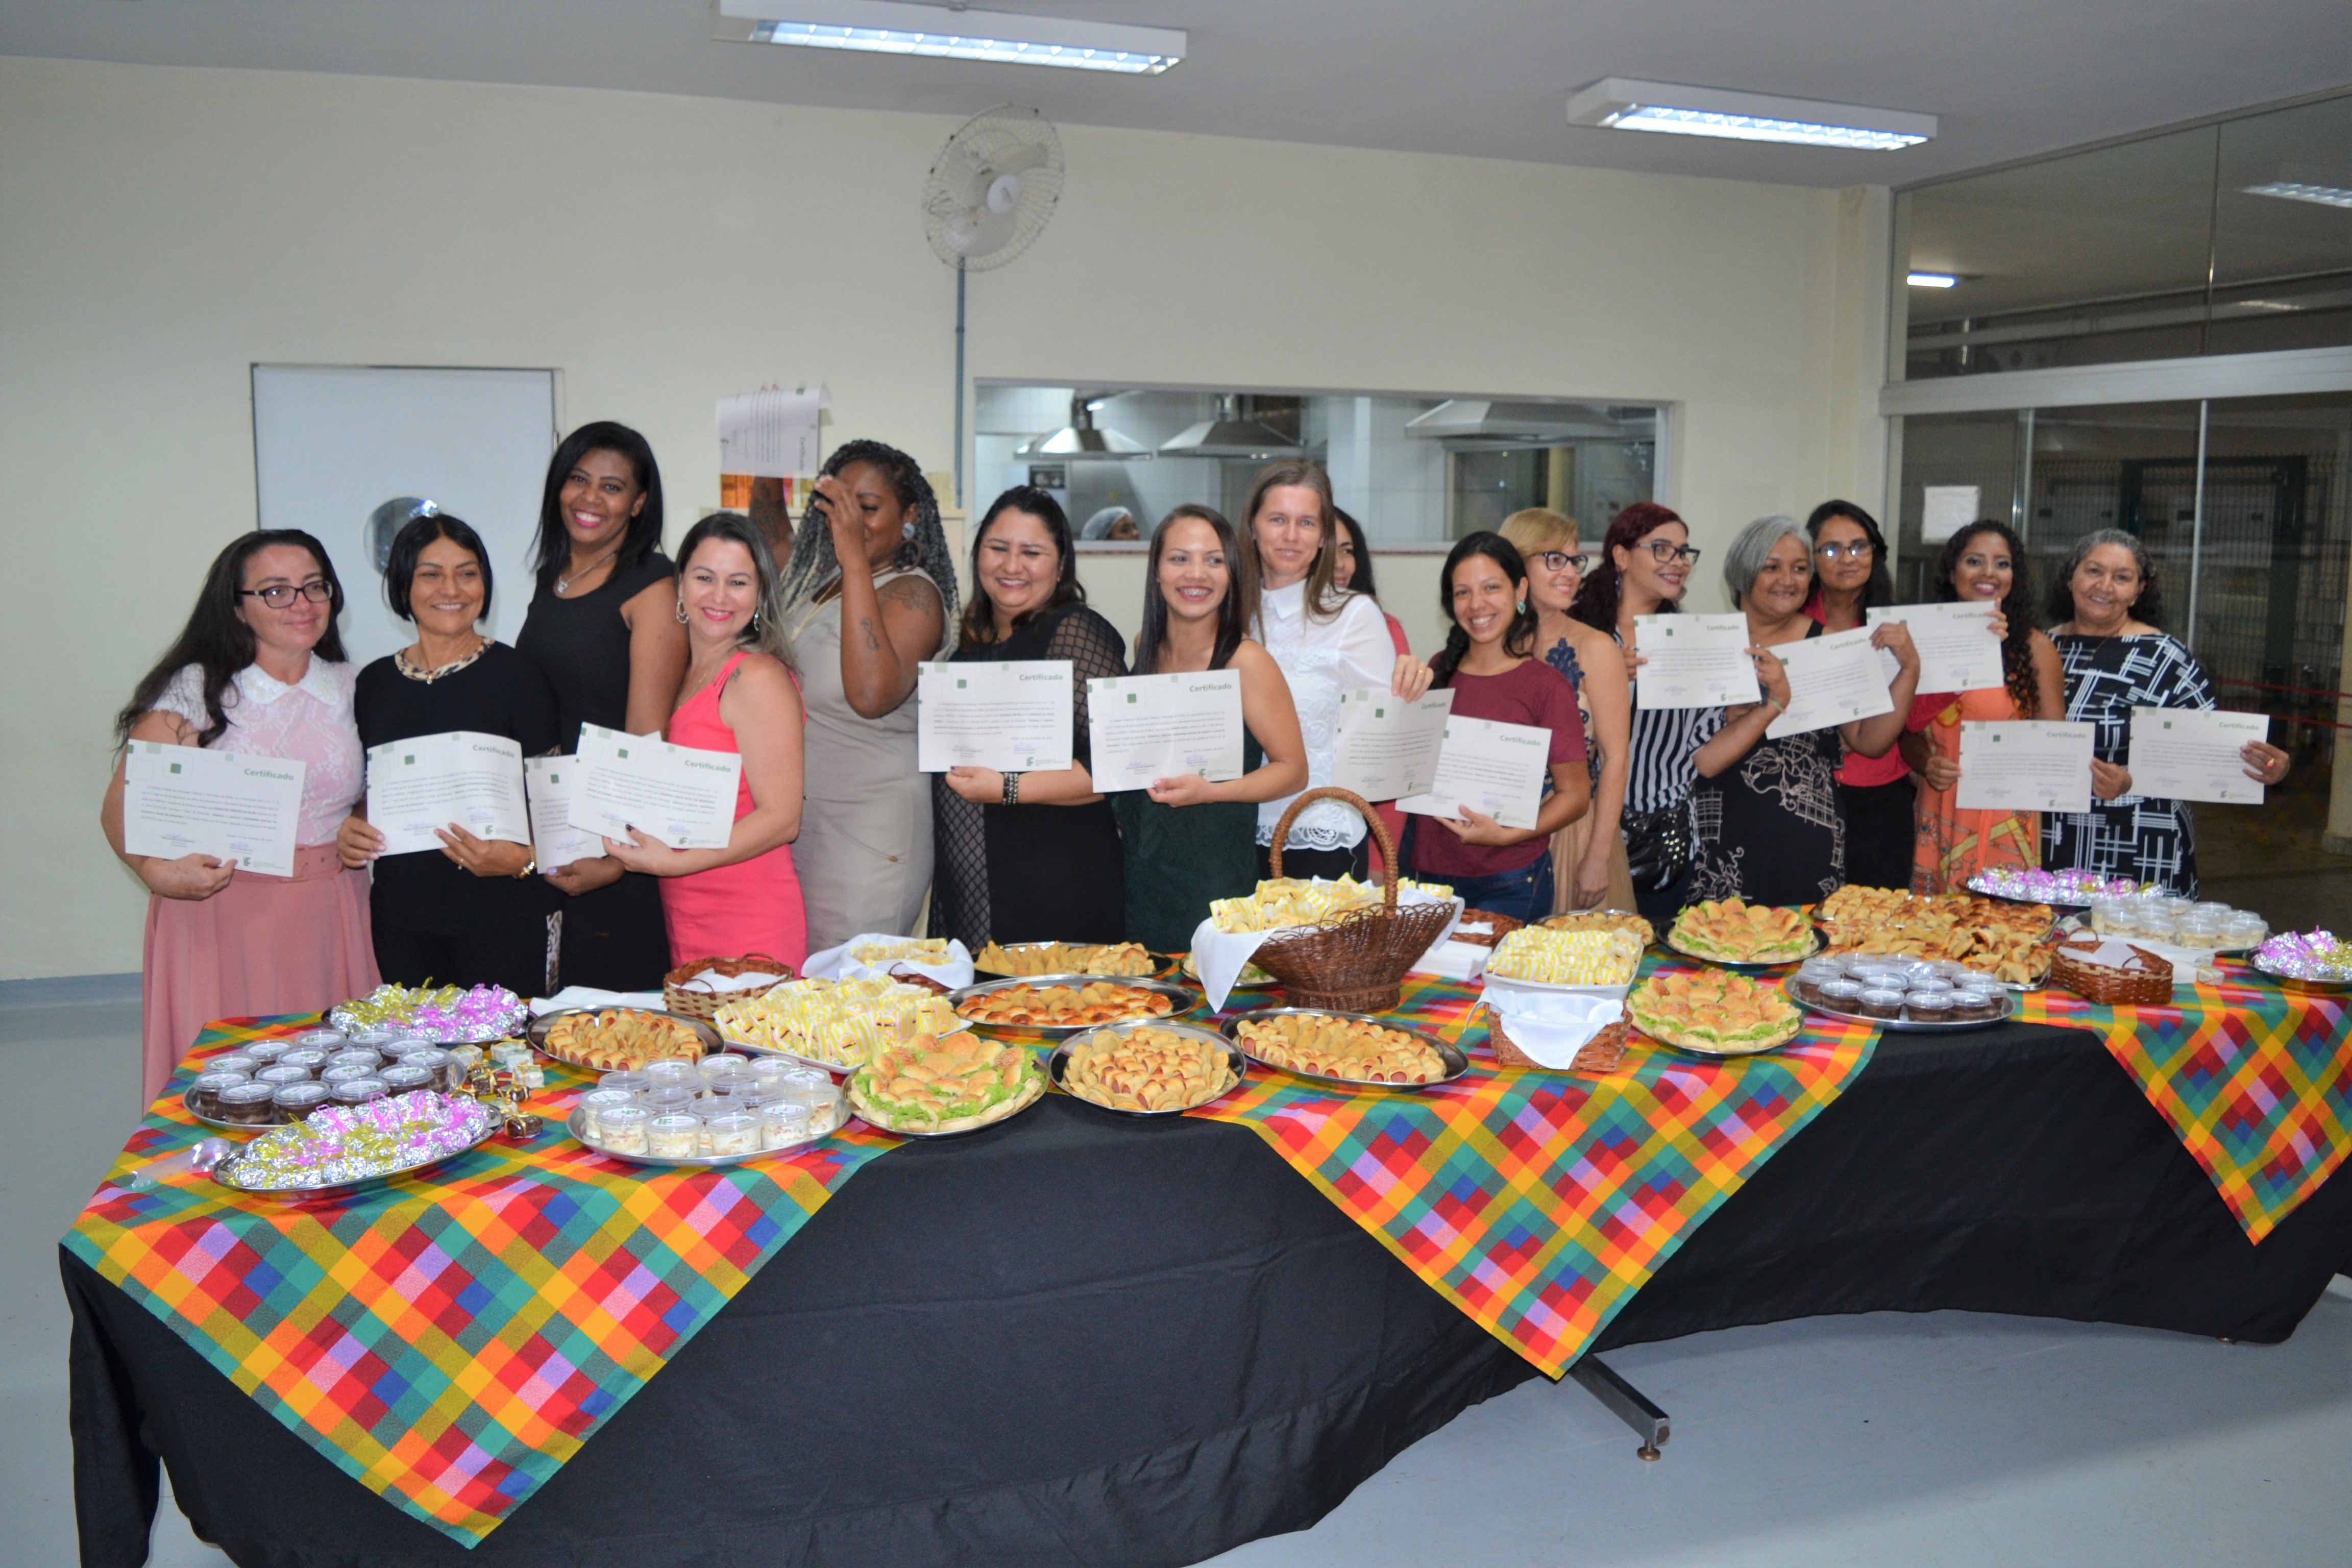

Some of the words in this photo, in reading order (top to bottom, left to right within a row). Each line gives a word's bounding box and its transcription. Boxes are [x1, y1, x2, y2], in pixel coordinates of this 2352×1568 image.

[1189, 683, 1232, 692] Certificado
[1420, 701, 1447, 710] Certificado
[2219, 722, 2260, 731] Certificado
[1500, 734, 1541, 747] Certificado
[2046, 731, 2087, 739] Certificado
[473, 744, 514, 758] Certificado
[684, 760, 731, 773] Certificado
[244, 767, 295, 781] Certificado
